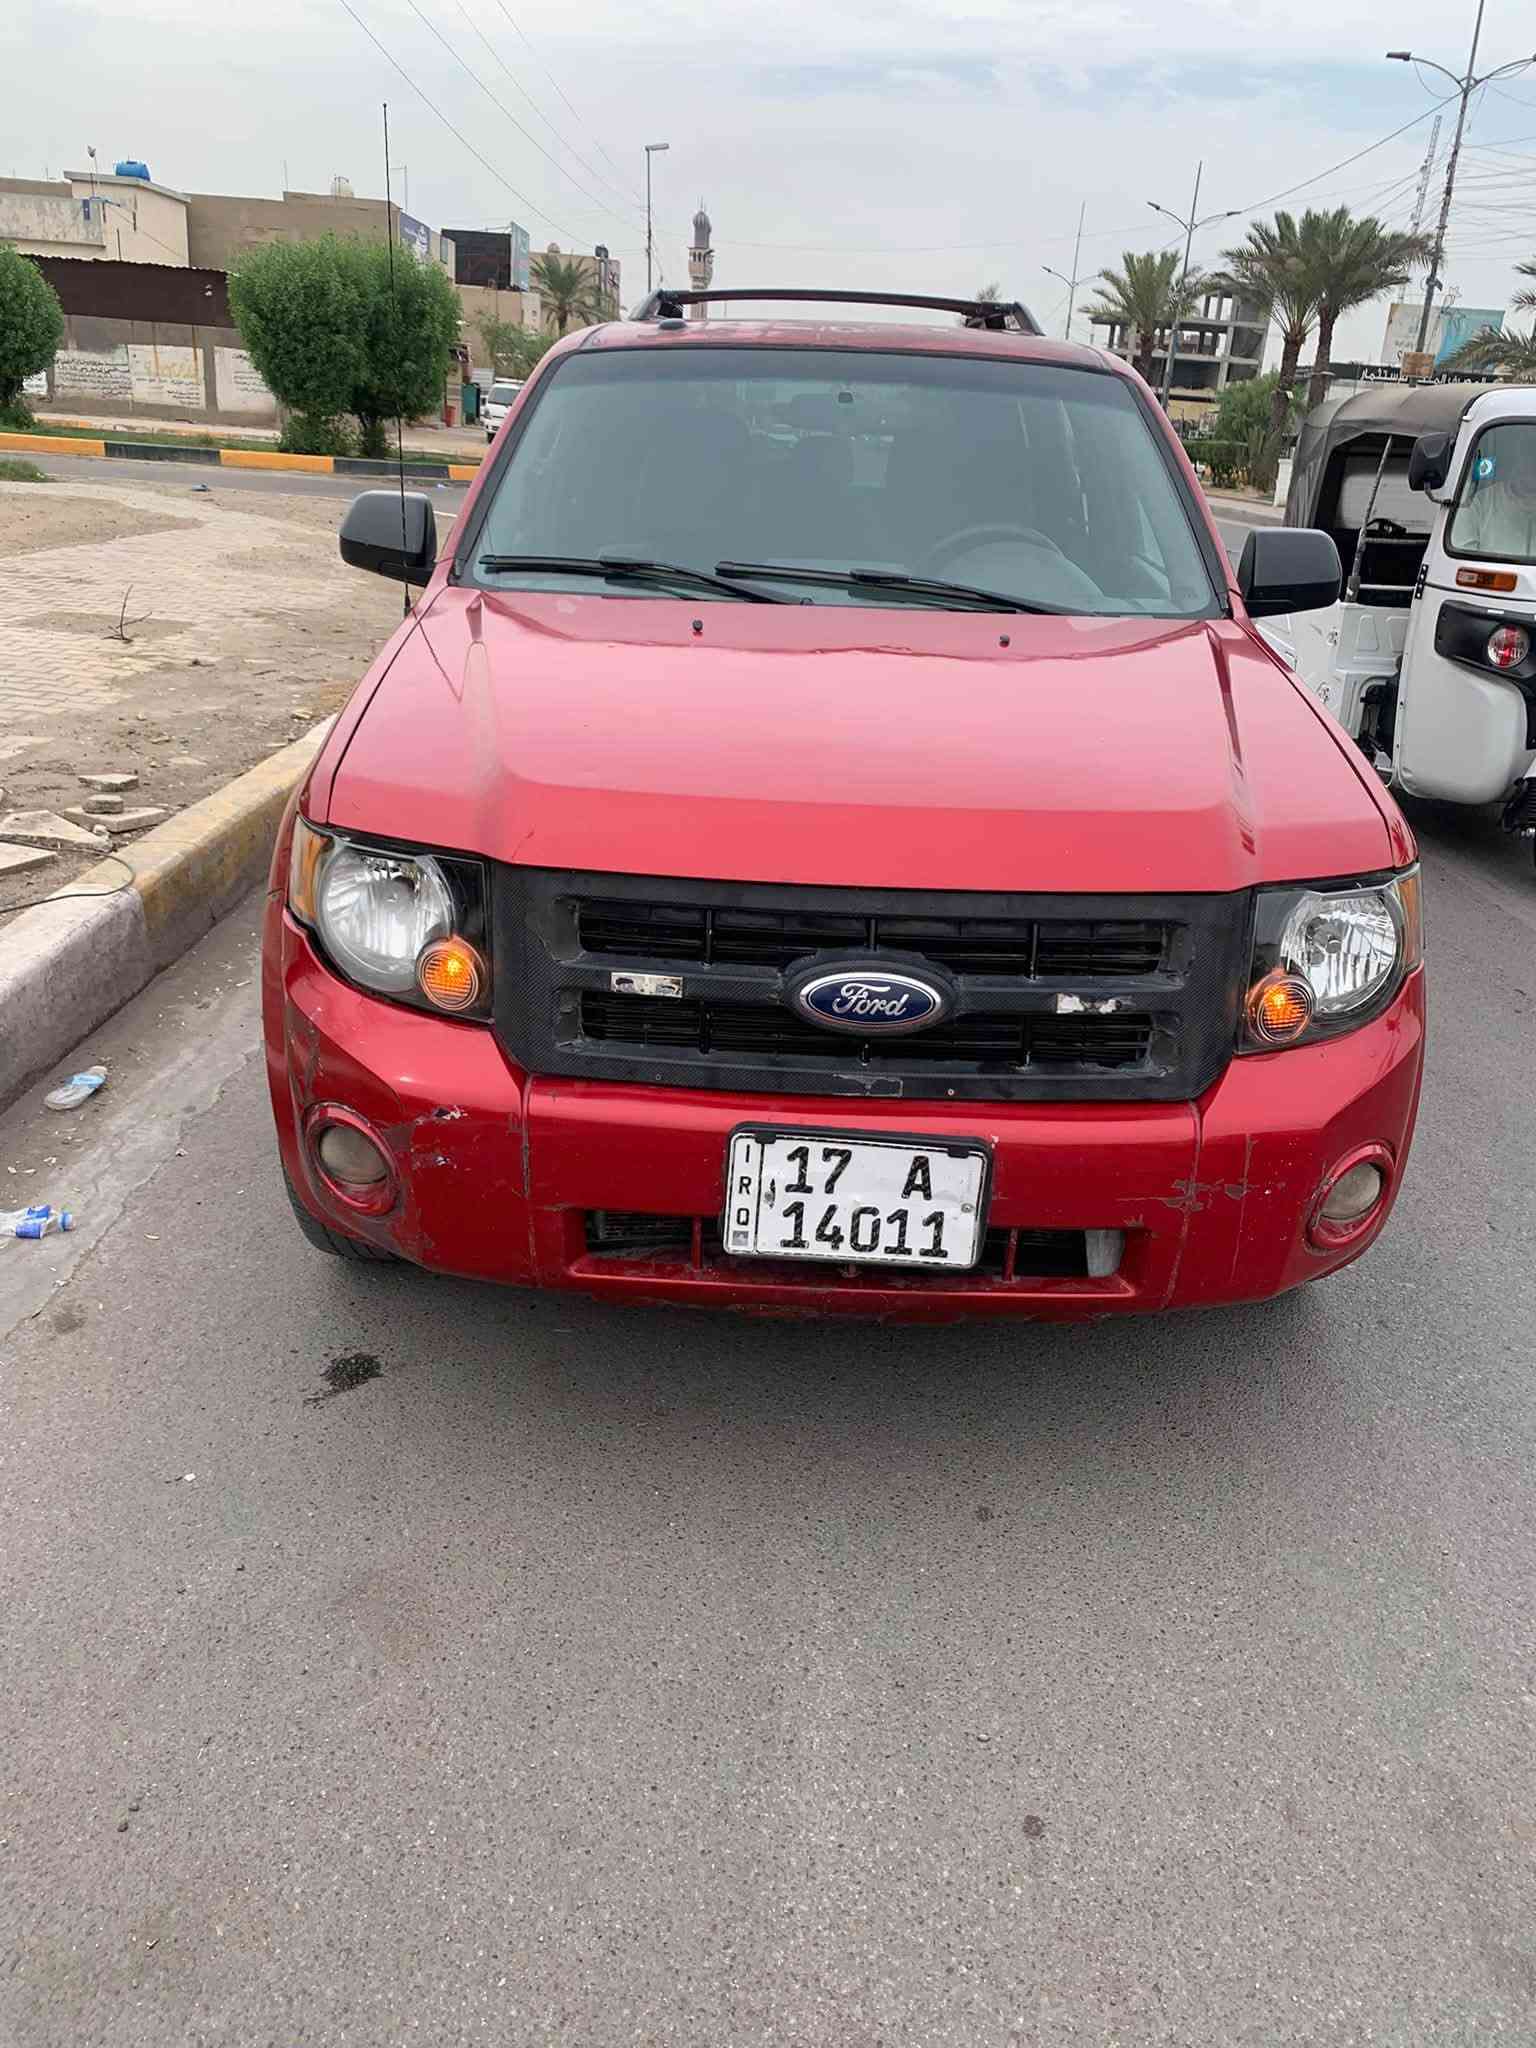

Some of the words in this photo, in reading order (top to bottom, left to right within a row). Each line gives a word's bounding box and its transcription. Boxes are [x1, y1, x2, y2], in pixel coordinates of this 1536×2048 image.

[831, 982, 910, 1016] Ford
[735, 1143, 752, 1227] IRQ
[784, 1146, 853, 1194] 17
[900, 1155, 932, 1200] A
[779, 1201, 948, 1258] 14011
